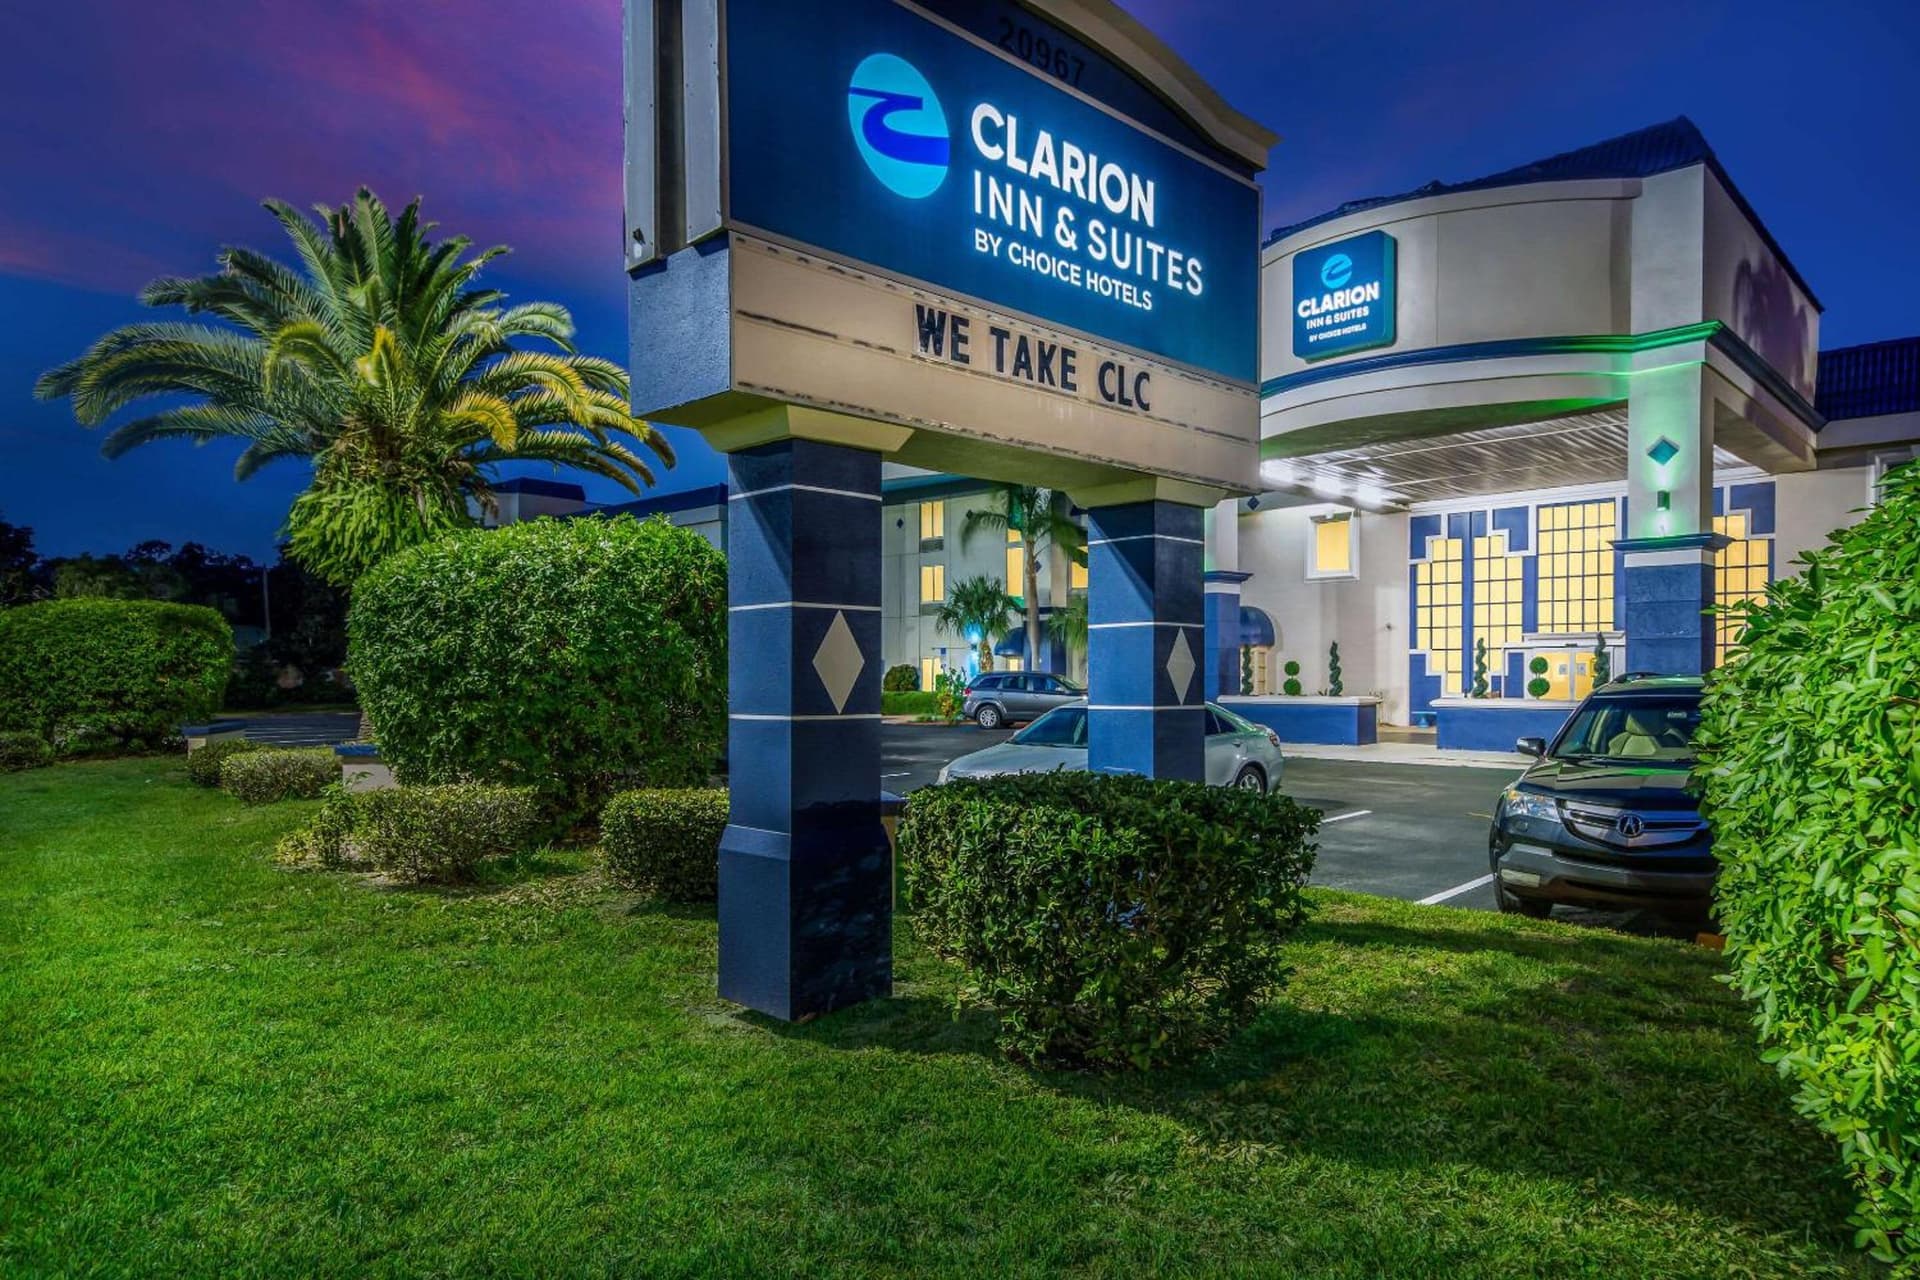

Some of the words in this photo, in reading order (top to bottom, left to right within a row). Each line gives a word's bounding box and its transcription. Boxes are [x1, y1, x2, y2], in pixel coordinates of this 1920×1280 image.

[999, 17, 1087, 87] 20967
[971, 103, 1155, 227] CLARION
[974, 171, 1043, 238] INN
[1054, 207, 1078, 251] &
[1088, 219, 1203, 296] SUITES
[975, 229, 1002, 257] BY
[1008, 242, 1082, 286] CHOICE
[1086, 272, 1153, 311] HOTELS
[1298, 281, 1380, 318] CLARION
[1306, 318, 1324, 330] INN
[1325, 314, 1333, 325] &
[1334, 306, 1370, 323] SUITES
[1309, 334, 1318, 342] BY
[1319, 329, 1342, 340] CHOICE
[1342, 323, 1367, 335] HOTELS
[916, 304, 971, 364] WE
[990, 327, 1078, 392] TAKE
[1098, 361, 1151, 412] CLC
